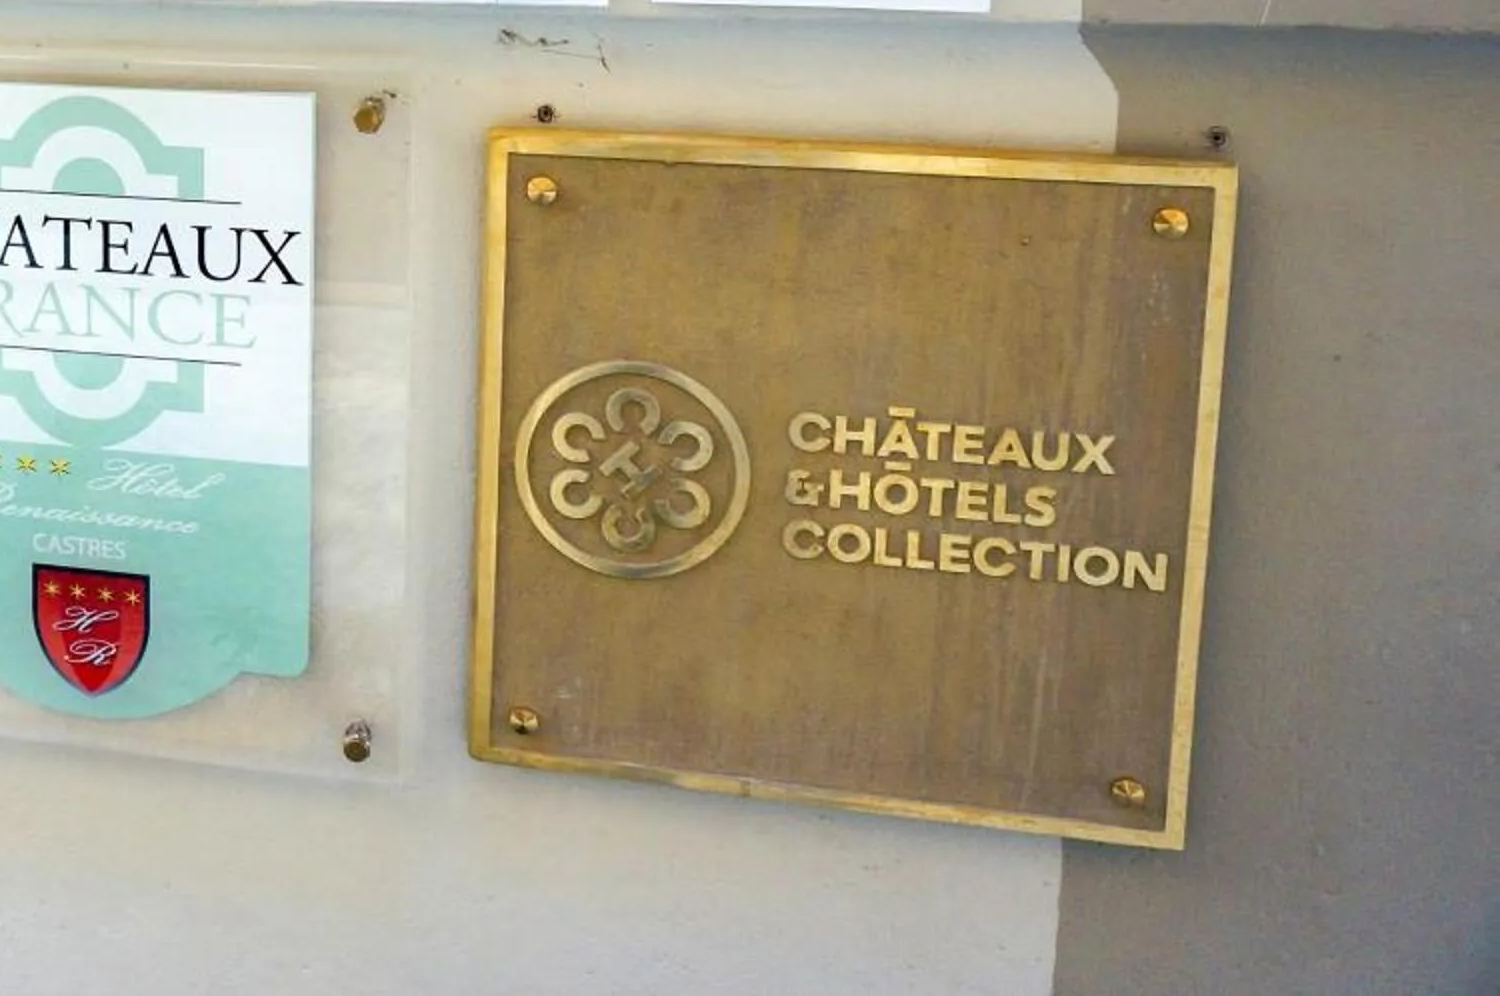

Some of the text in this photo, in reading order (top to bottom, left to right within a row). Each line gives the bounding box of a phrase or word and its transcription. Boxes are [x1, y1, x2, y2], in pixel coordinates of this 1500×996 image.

[88, 459, 225, 500] Hôtel
[33, 533, 127, 560] CASTRES
[781, 520, 1169, 593] COLLECTION
